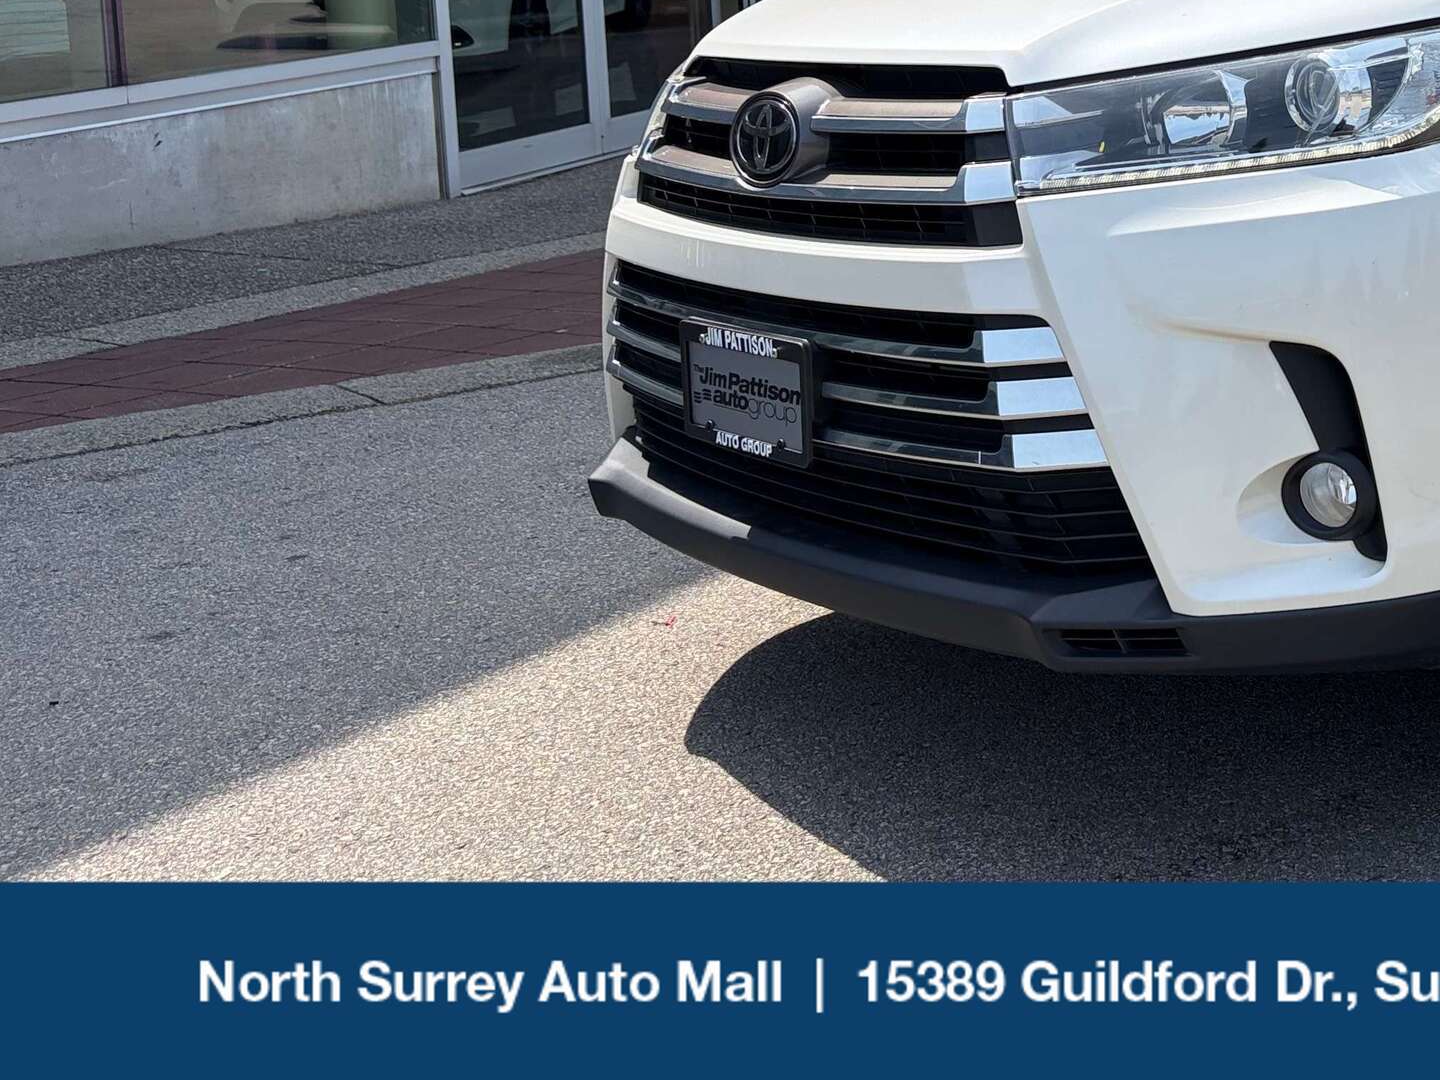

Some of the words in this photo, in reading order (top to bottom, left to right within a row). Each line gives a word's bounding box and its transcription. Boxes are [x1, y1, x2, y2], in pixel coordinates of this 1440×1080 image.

[705, 327, 724, 348] JIM
[724, 330, 774, 358] PATTISON
[715, 431, 740, 450] AUTO
[740, 436, 773, 458] GROUP
